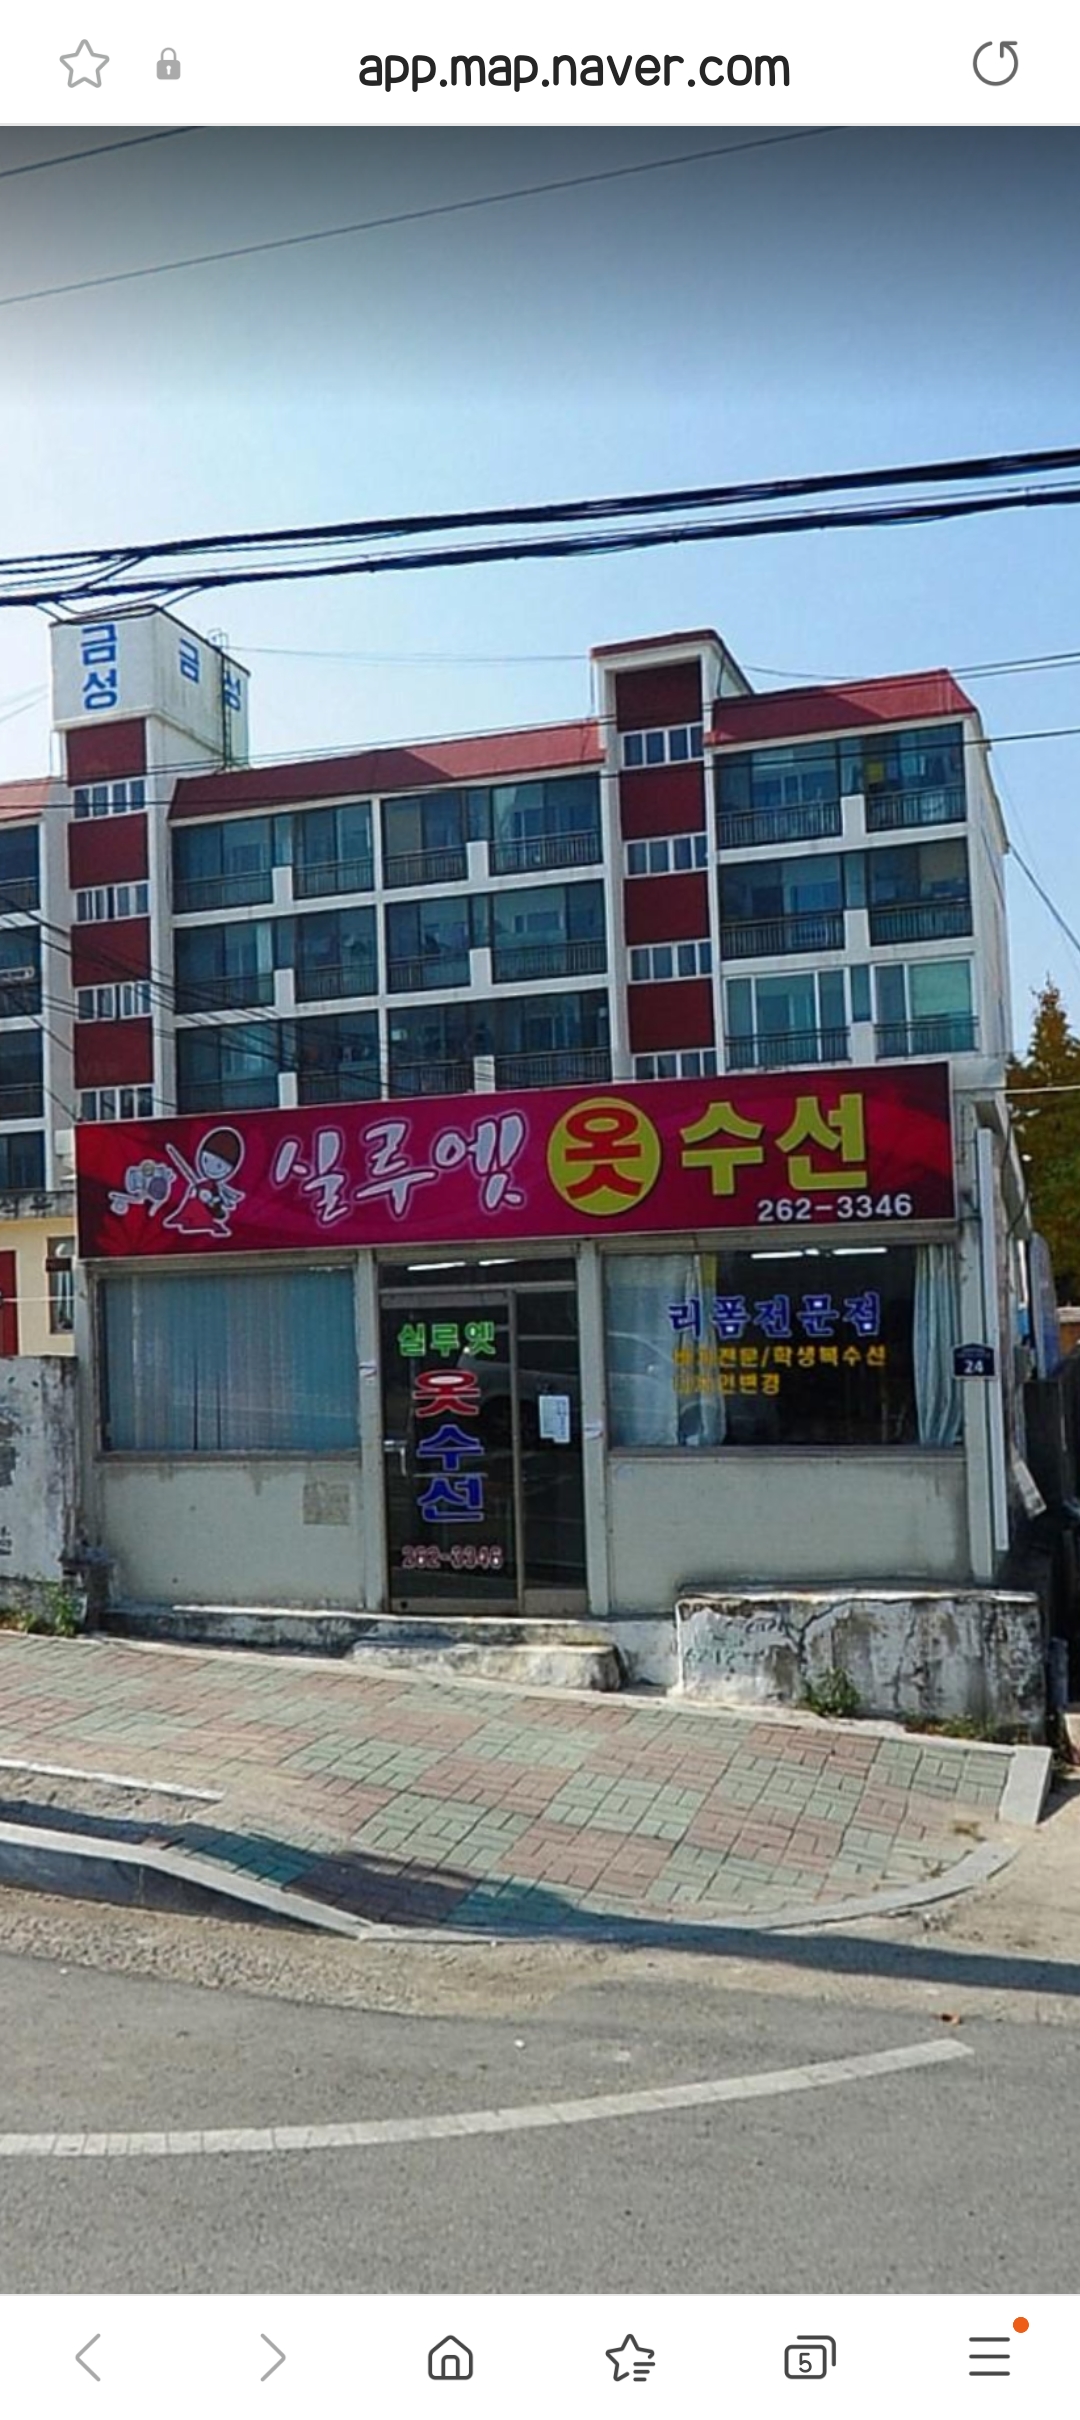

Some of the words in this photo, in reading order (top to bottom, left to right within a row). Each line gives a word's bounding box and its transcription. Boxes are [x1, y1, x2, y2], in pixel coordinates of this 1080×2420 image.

[80, 622, 119, 711] 금성
[756, 1193, 915, 1223] 262-3346
[668, 1292, 880, 1339] 리폼전문점
[963, 1358, 985, 1374] 24
[400, 1544, 505, 1571] 262-3346
